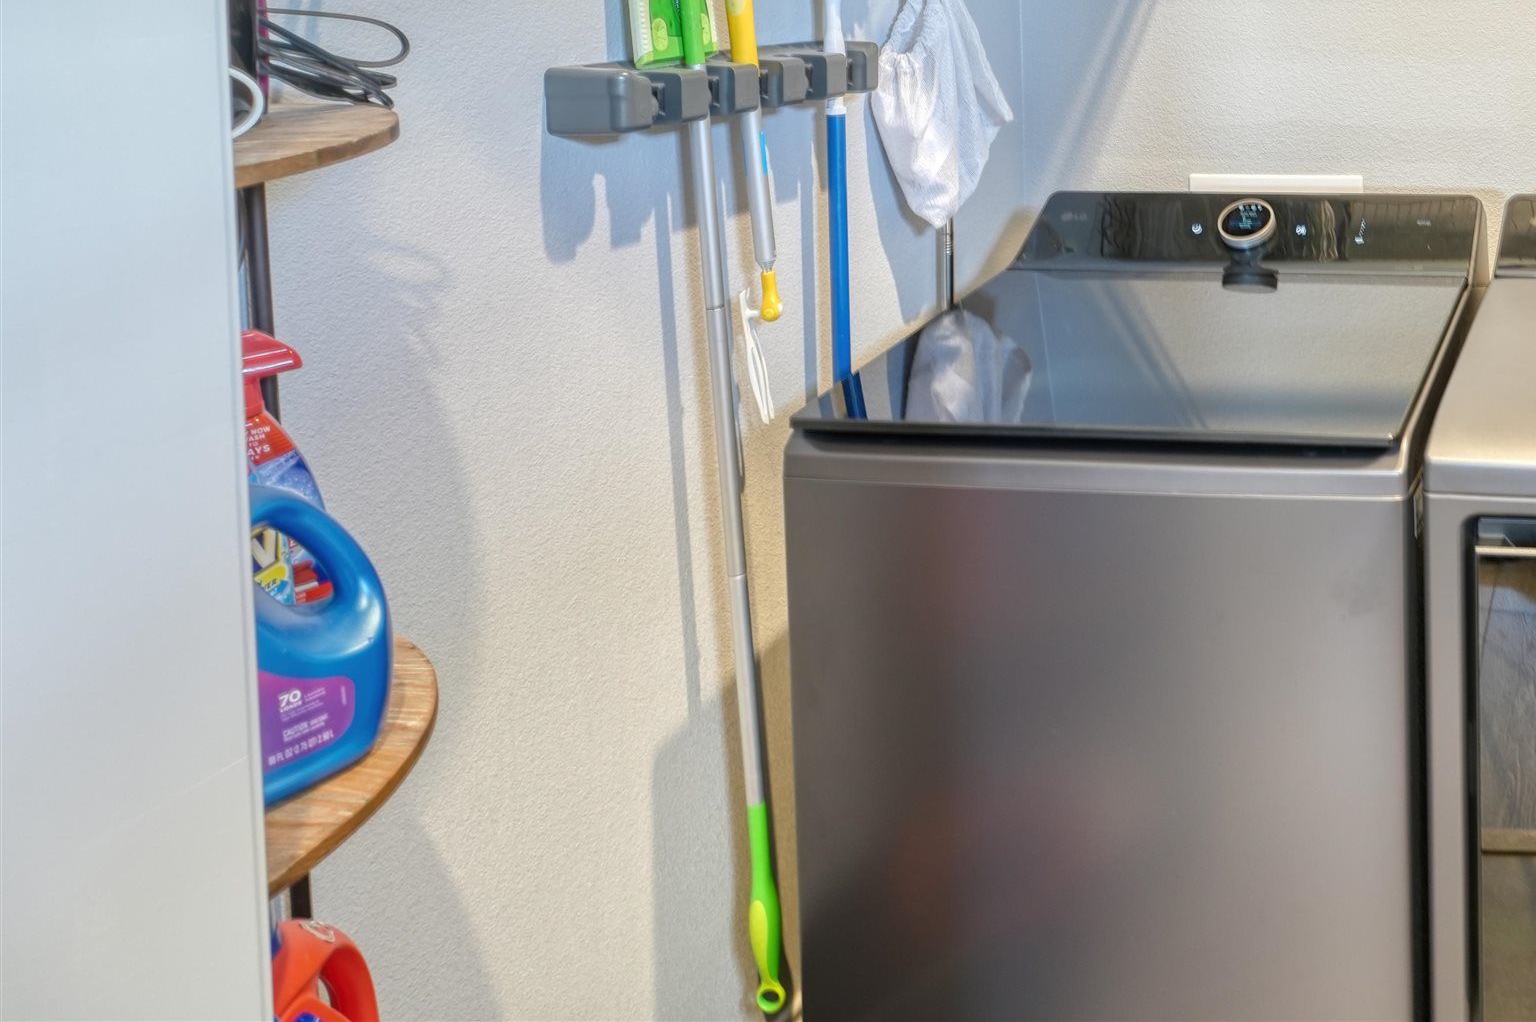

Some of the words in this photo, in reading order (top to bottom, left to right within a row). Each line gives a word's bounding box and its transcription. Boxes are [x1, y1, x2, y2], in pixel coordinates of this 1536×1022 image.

[251, 425, 271, 435] NOW
[248, 433, 266, 442] ASH
[247, 444, 271, 456] AYS
[278, 689, 302, 708] 70
